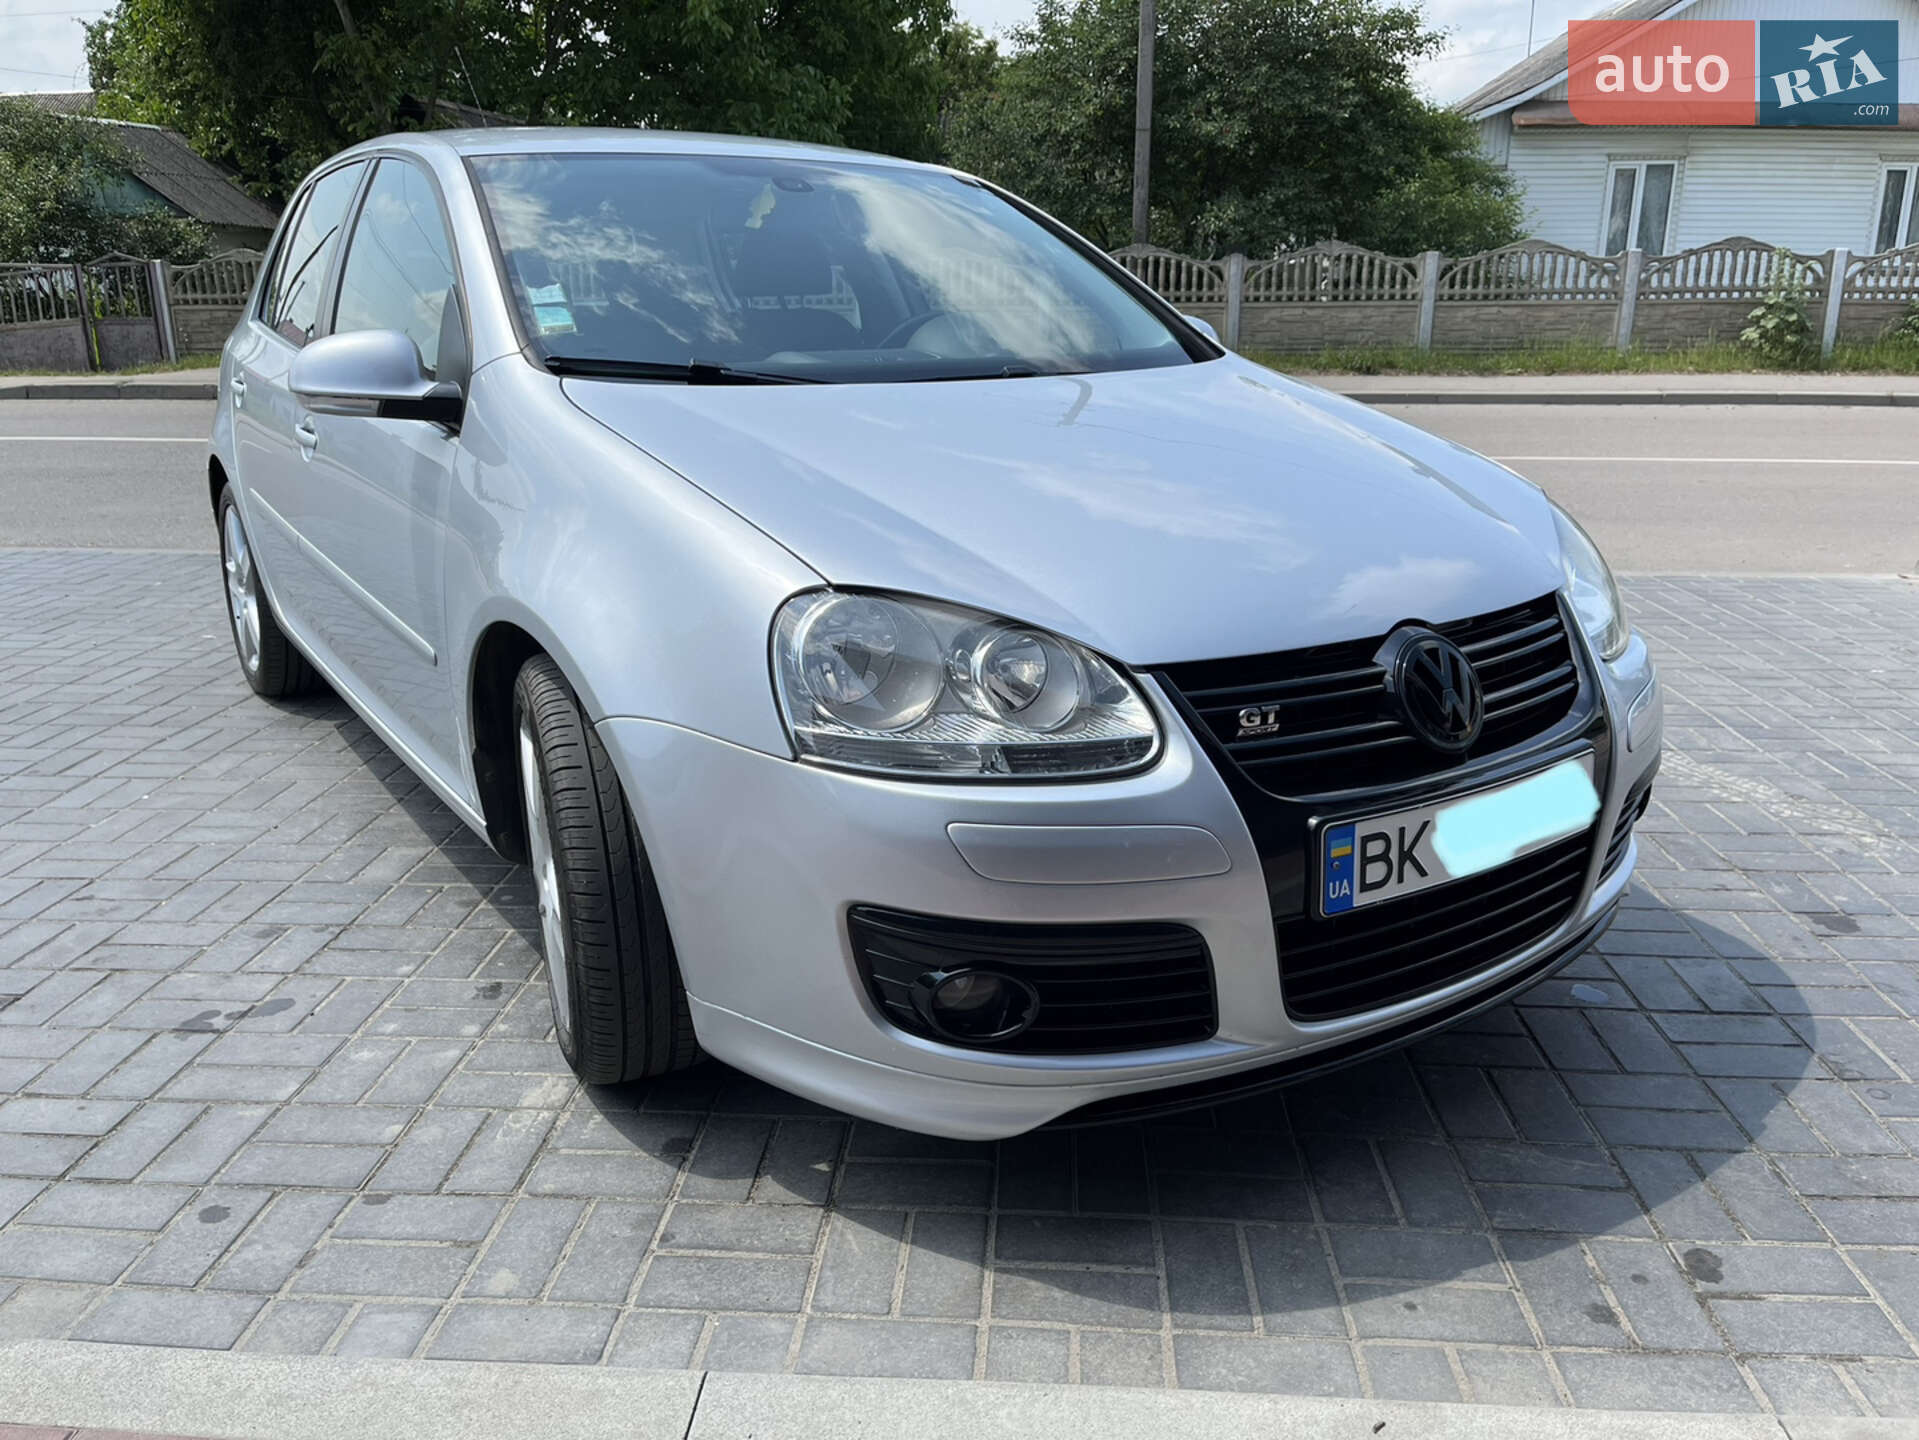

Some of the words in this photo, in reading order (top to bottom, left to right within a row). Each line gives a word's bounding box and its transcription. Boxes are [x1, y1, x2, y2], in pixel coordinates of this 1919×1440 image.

[1239, 705, 1280, 727] GT
[1359, 820, 1431, 893] BK
[1329, 879, 1350, 898] UA
